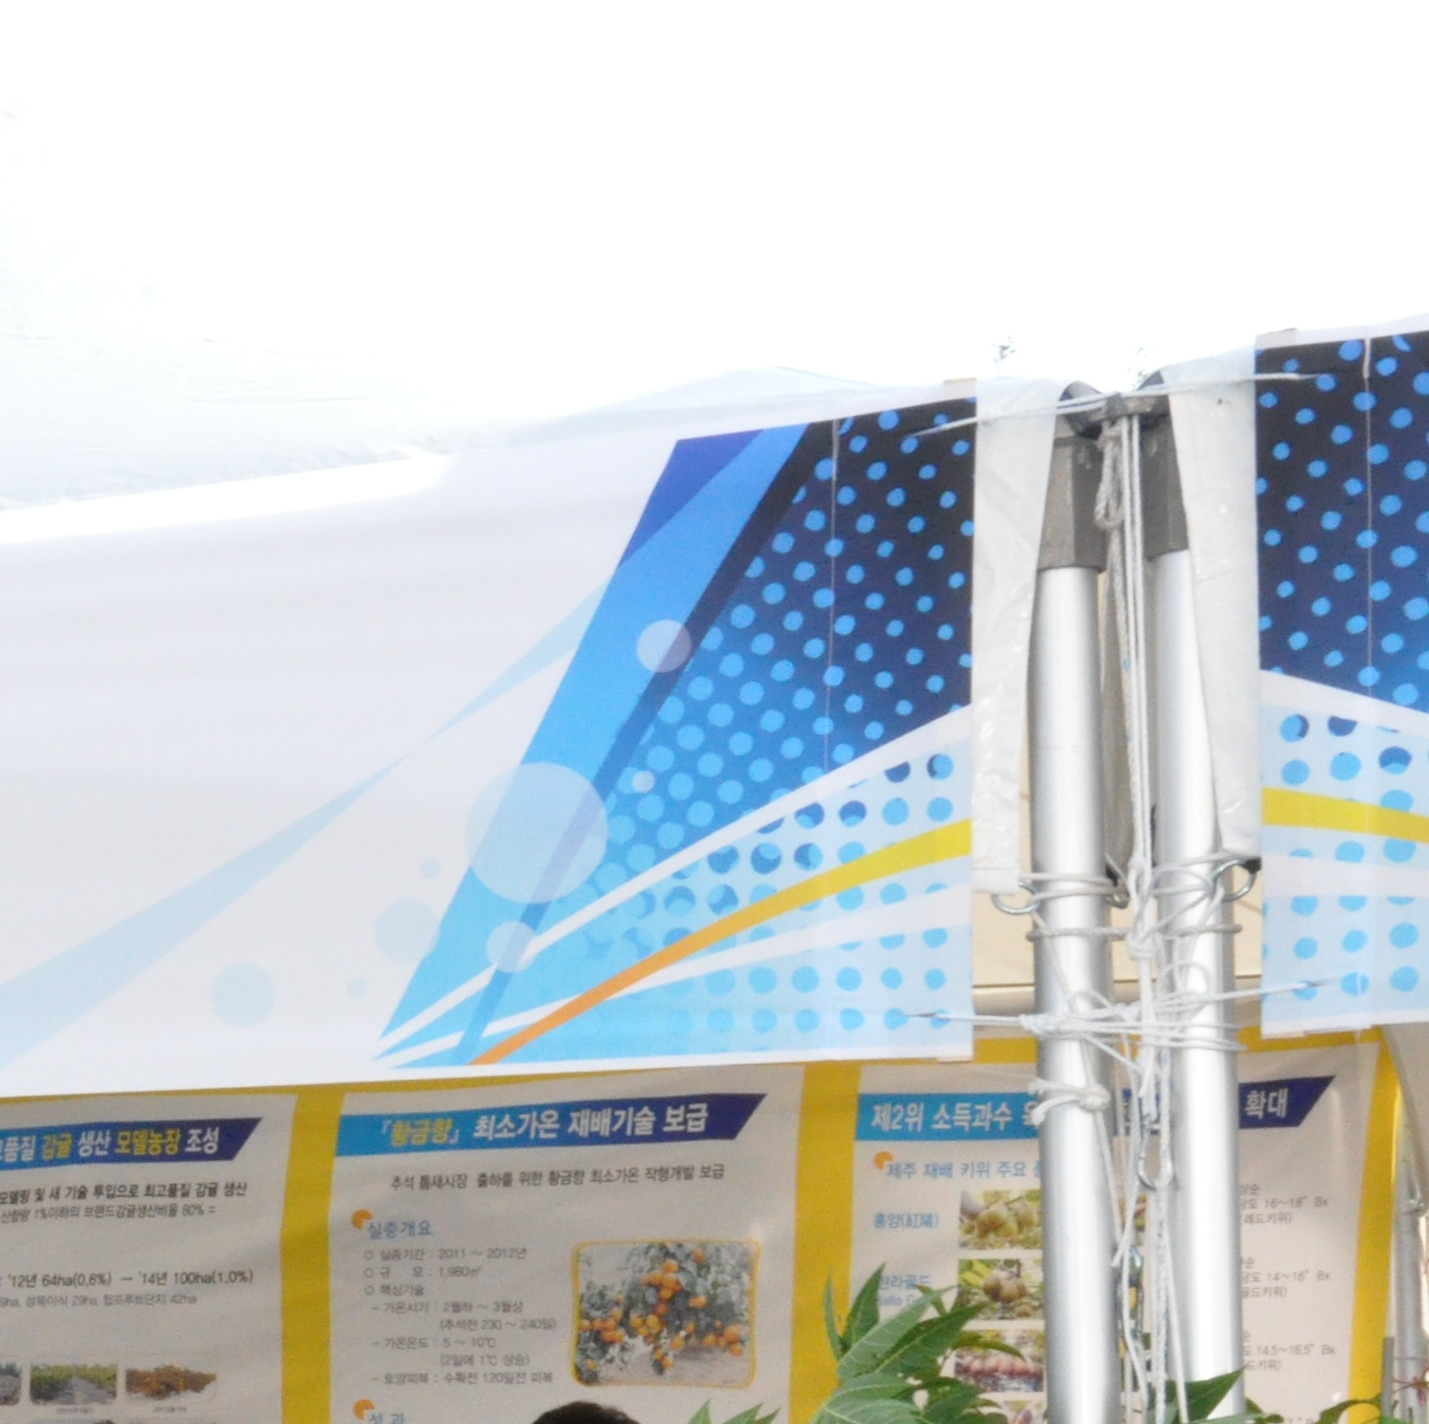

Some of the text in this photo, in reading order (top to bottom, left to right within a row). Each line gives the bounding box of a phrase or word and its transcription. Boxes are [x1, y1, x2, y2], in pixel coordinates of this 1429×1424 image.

[473, 1108, 562, 1143] 최소가온
[567, 1105, 656, 1139] 재배기술
[662, 1102, 710, 1134] 보급
[871, 1088, 1289, 1132] 제2위 소득과수 확대
[42, 1133, 72, 1160] 감귤
[78, 1129, 109, 1157] 생산
[115, 1127, 182, 1156] 모델농장
[185, 1126, 220, 1155] 조성
[419, 1173, 469, 1190] 틈새시장
[476, 1171, 513, 1188] 출하를
[518, 1170, 543, 1187] 위한
[591, 1166, 642, 1185] 최소가온
[699, 1162, 725, 1180] 보급
[887, 1162, 916, 1179] 제주
[961, 1161, 990, 1178] 키위
[997, 1161, 1026, 1178] 주요
